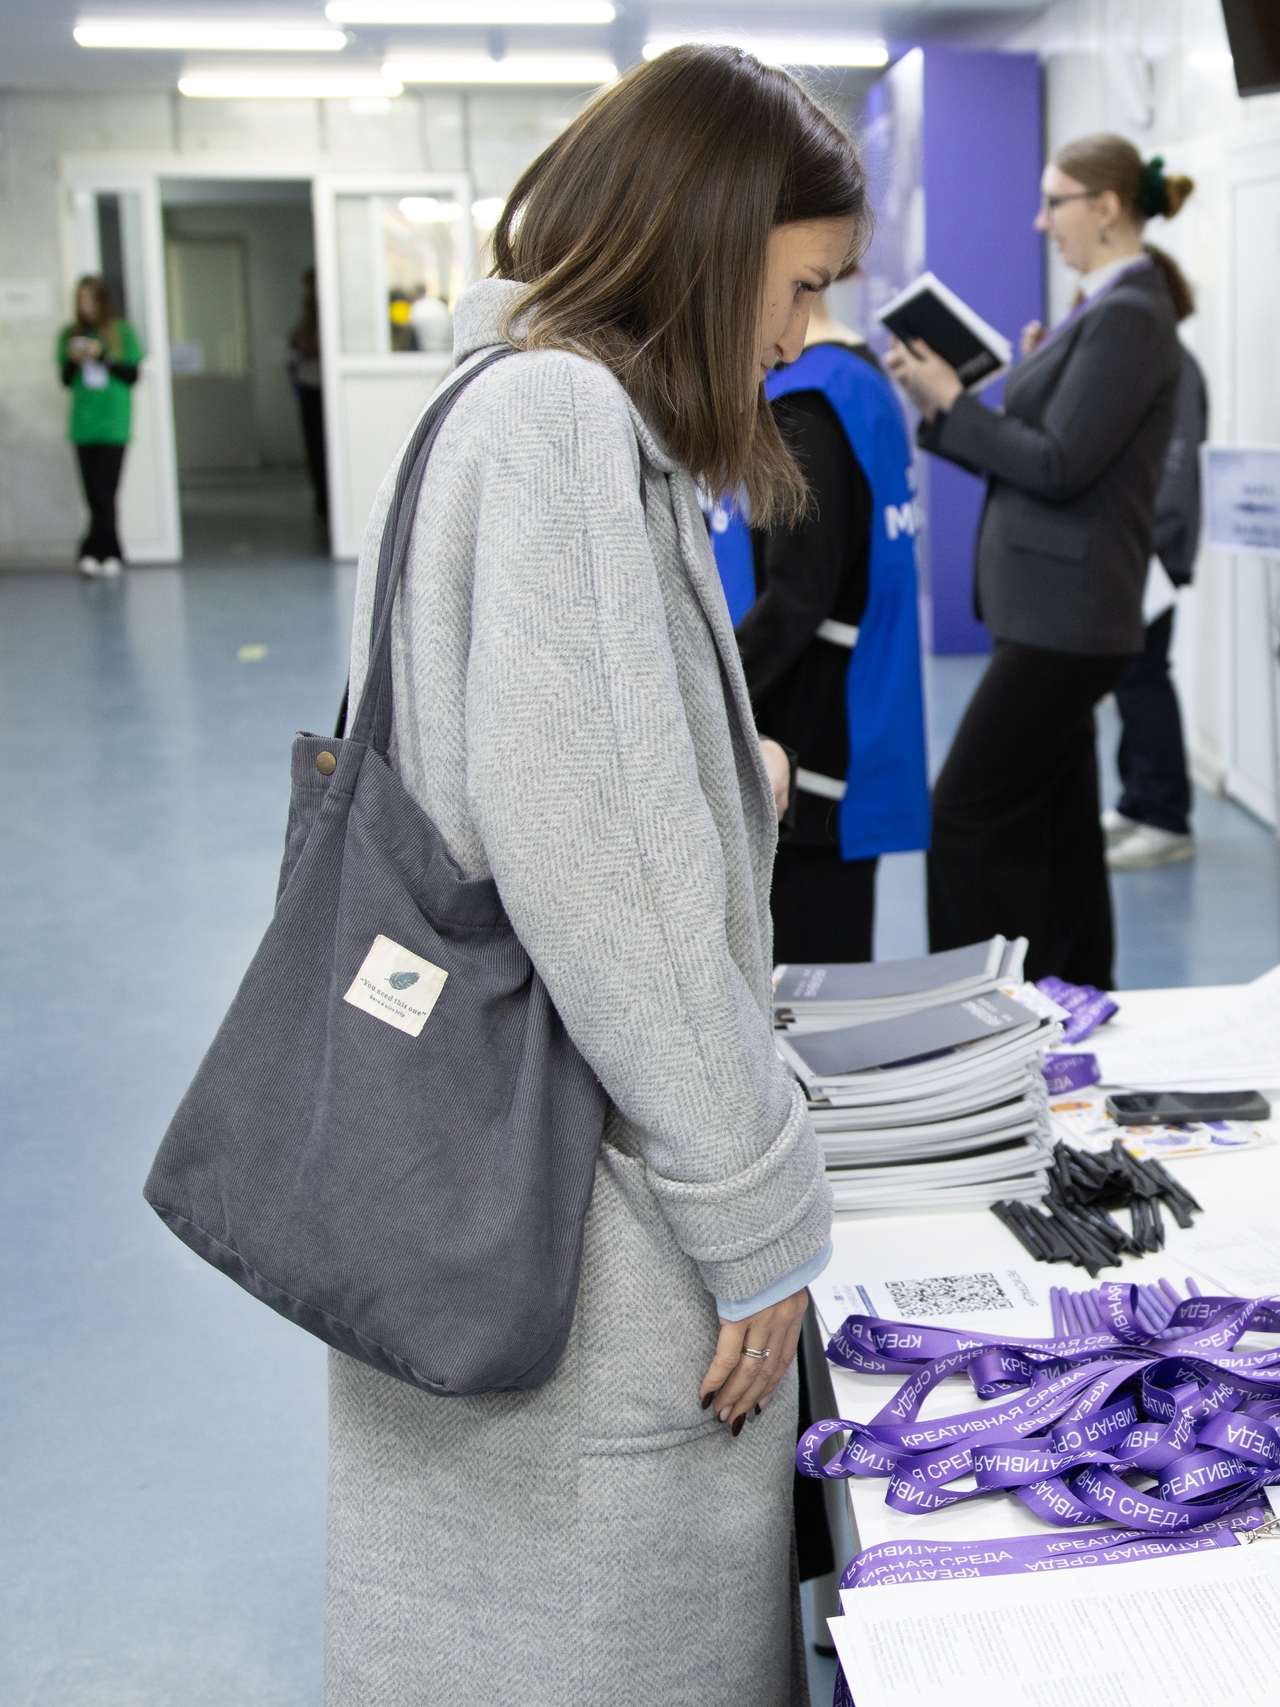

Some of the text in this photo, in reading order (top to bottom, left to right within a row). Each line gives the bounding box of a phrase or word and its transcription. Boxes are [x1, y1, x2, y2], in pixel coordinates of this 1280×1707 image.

[376, 989, 394, 1002] need
[394, 997, 408, 1010] this
[890, 1372, 931, 1418] СРЕДА
[900, 1406, 1024, 1447] КРЕАТИВНАЯ
[1025, 1371, 1087, 1408] СРЕДА
[1227, 1424, 1275, 1460] СРЕДА
[974, 1450, 1098, 1474] КРЕАТИВНАЯ
[1119, 1496, 1190, 1526] СРЕДА
[940, 1550, 1014, 1567] СРЕДА
[1025, 1538, 1216, 1572] ЕАТИВНАЯ СРЕДА
